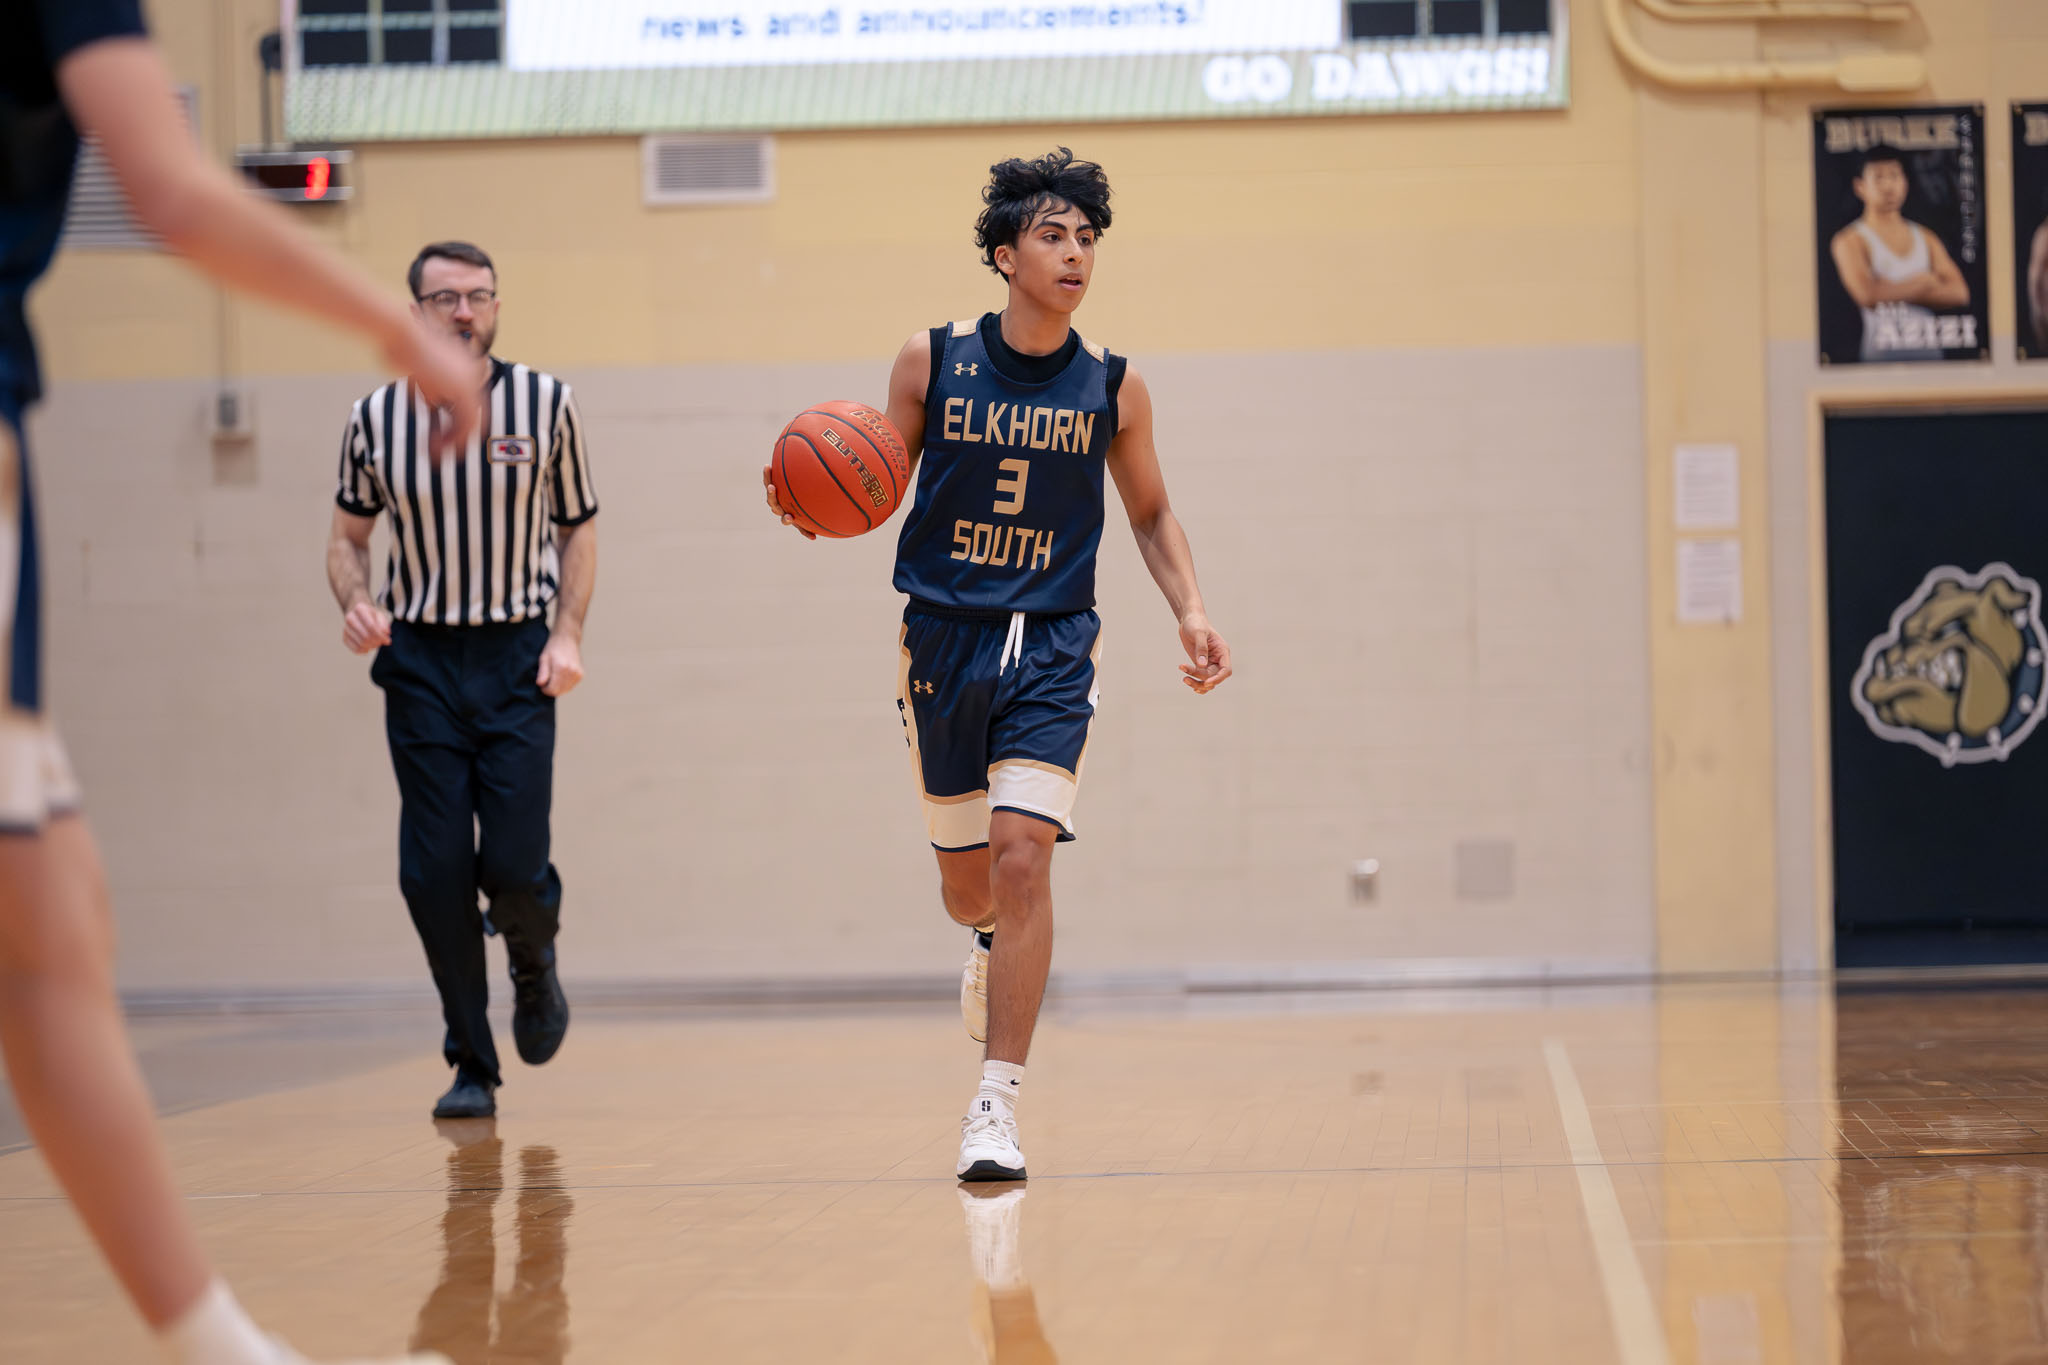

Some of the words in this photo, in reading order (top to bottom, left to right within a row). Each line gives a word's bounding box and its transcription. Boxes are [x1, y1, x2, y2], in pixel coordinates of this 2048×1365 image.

[642, 15, 747, 41] news
[767, 9, 839, 37] and
[1202, 54, 1293, 102] GO
[1310, 48, 1550, 98] DAWGS!
[943, 397, 1095, 454] ELKHORN
[821, 427, 873, 484] ELITE
[992, 458, 1030, 516] 3
[950, 519, 1054, 571] SOUTH
